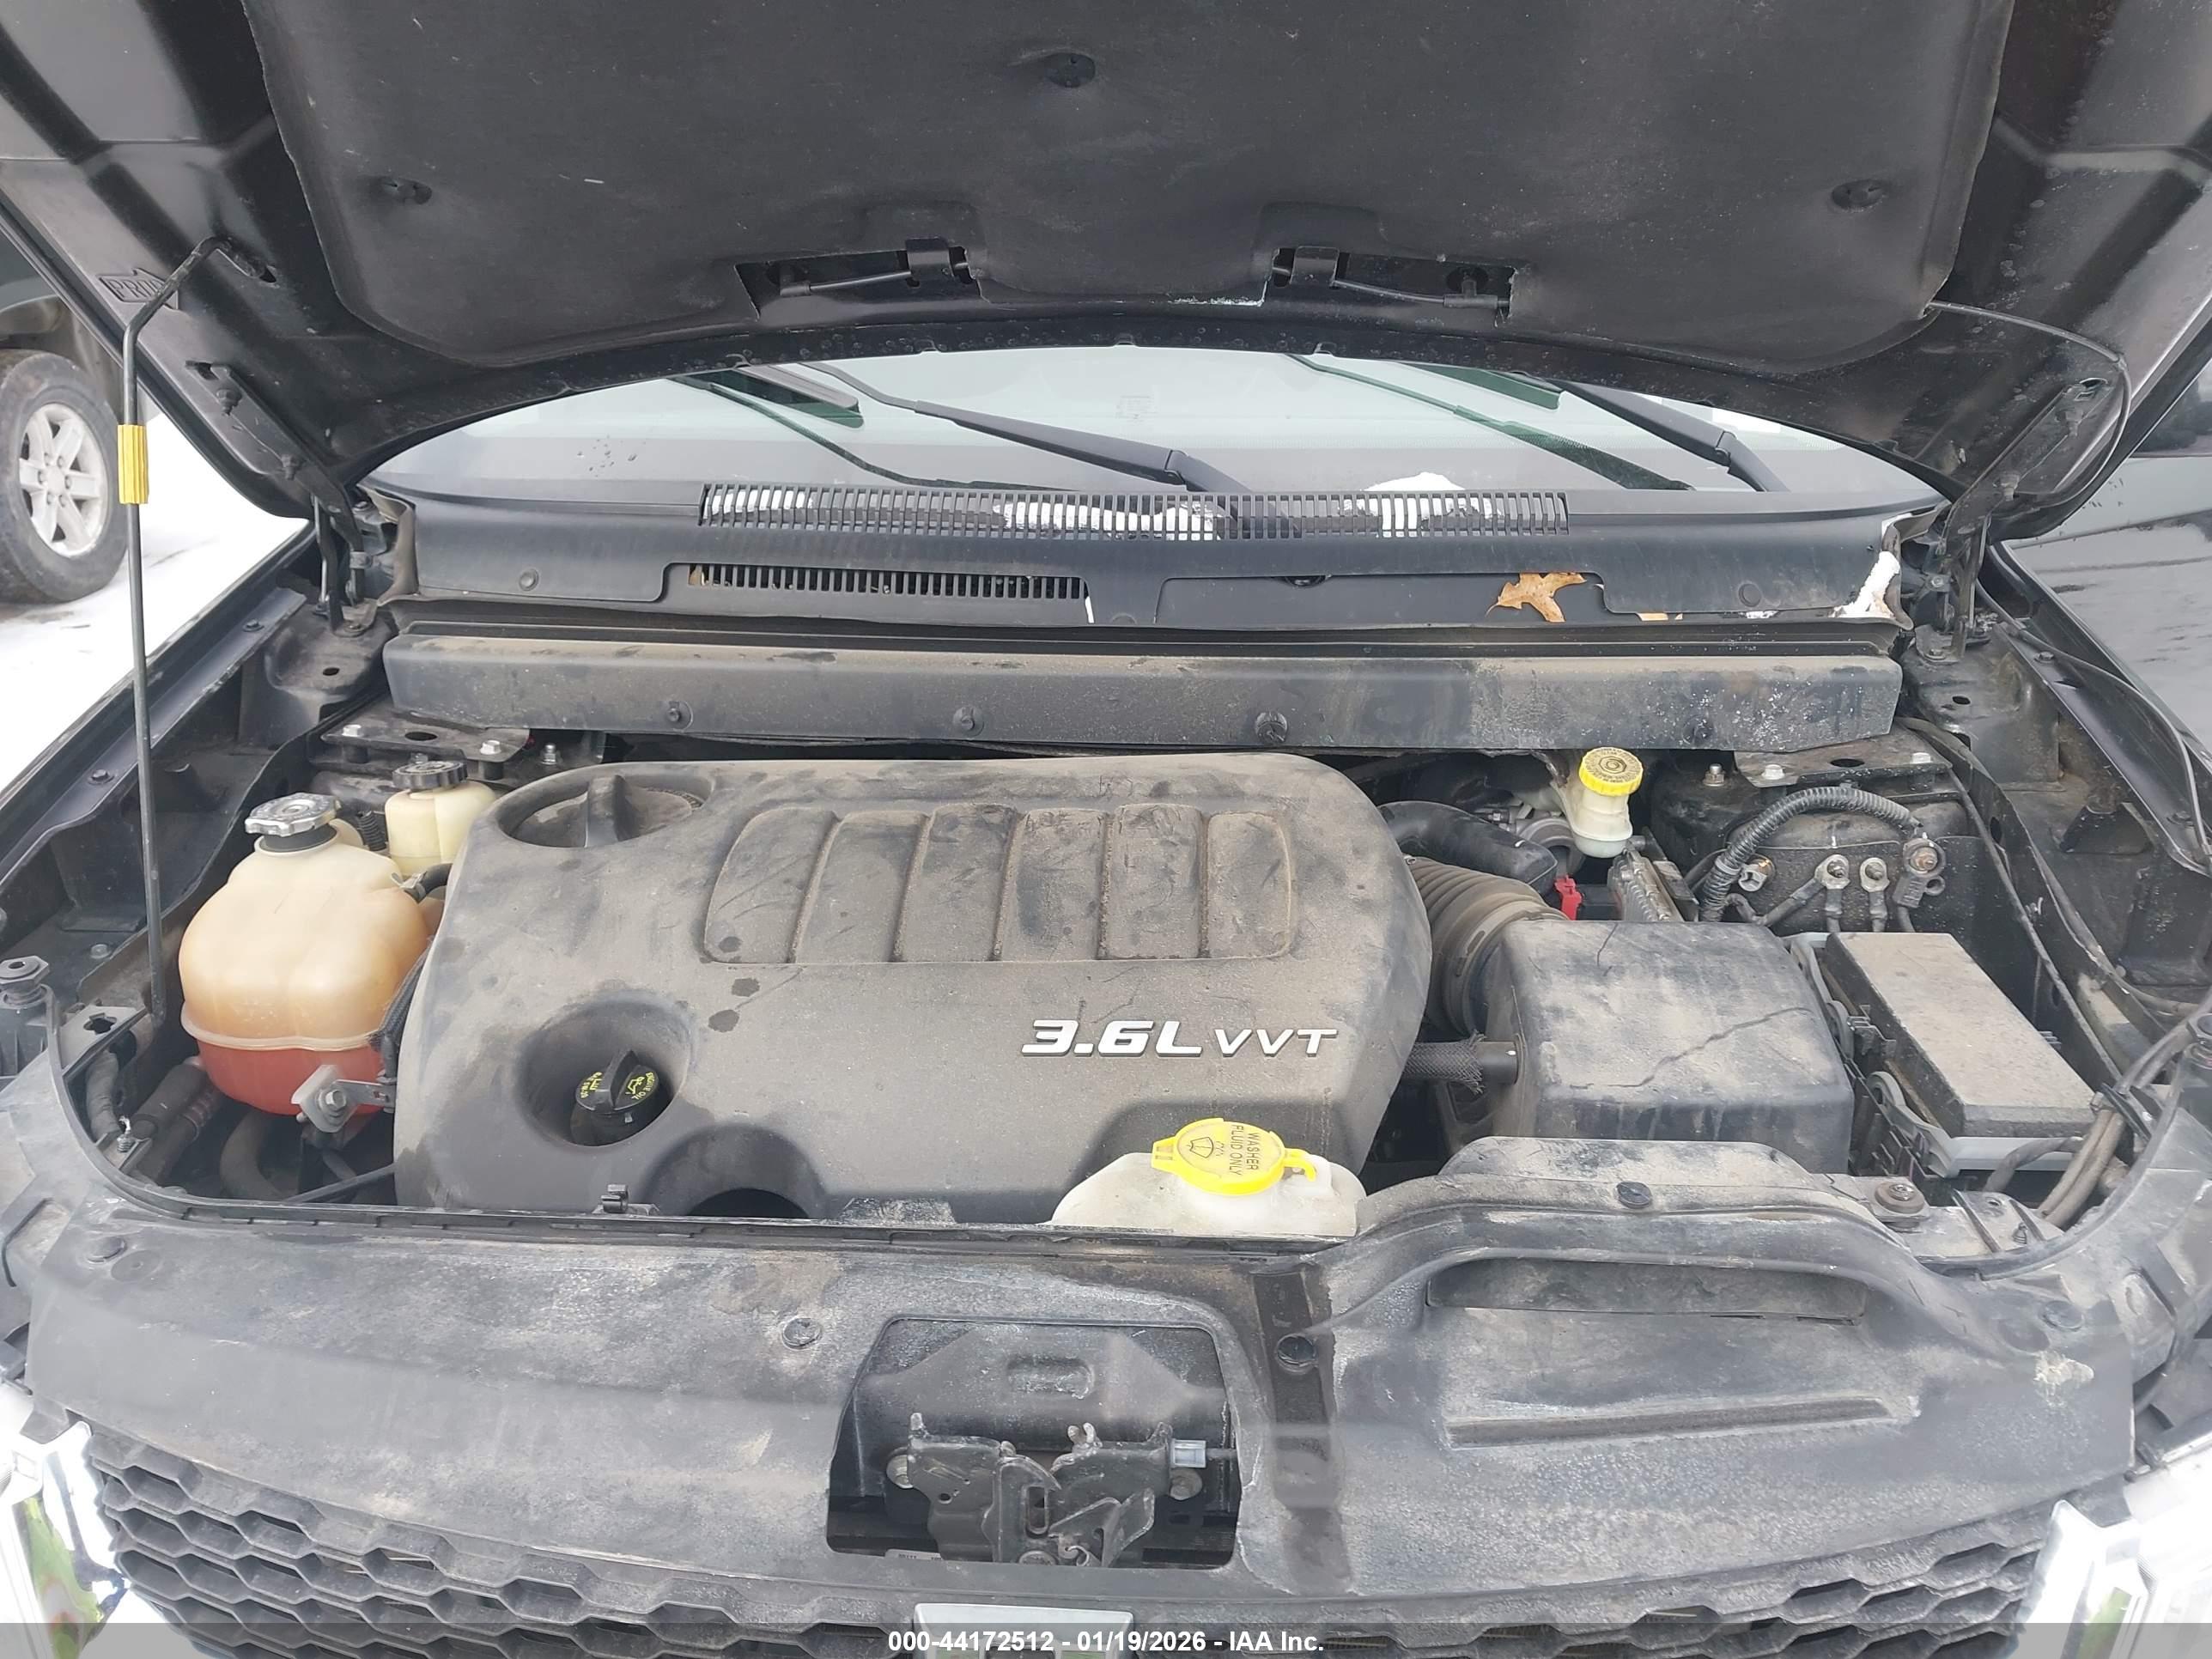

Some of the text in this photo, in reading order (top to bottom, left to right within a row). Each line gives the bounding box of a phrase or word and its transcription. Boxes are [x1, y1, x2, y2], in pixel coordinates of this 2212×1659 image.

[1021, 1019, 1338, 1057] 3.6L VVT
[631, 1091, 647, 1100] OIL
[1229, 1124, 1244, 1176] FLUID ONLY
[1246, 1132, 1261, 1170] WASHER
